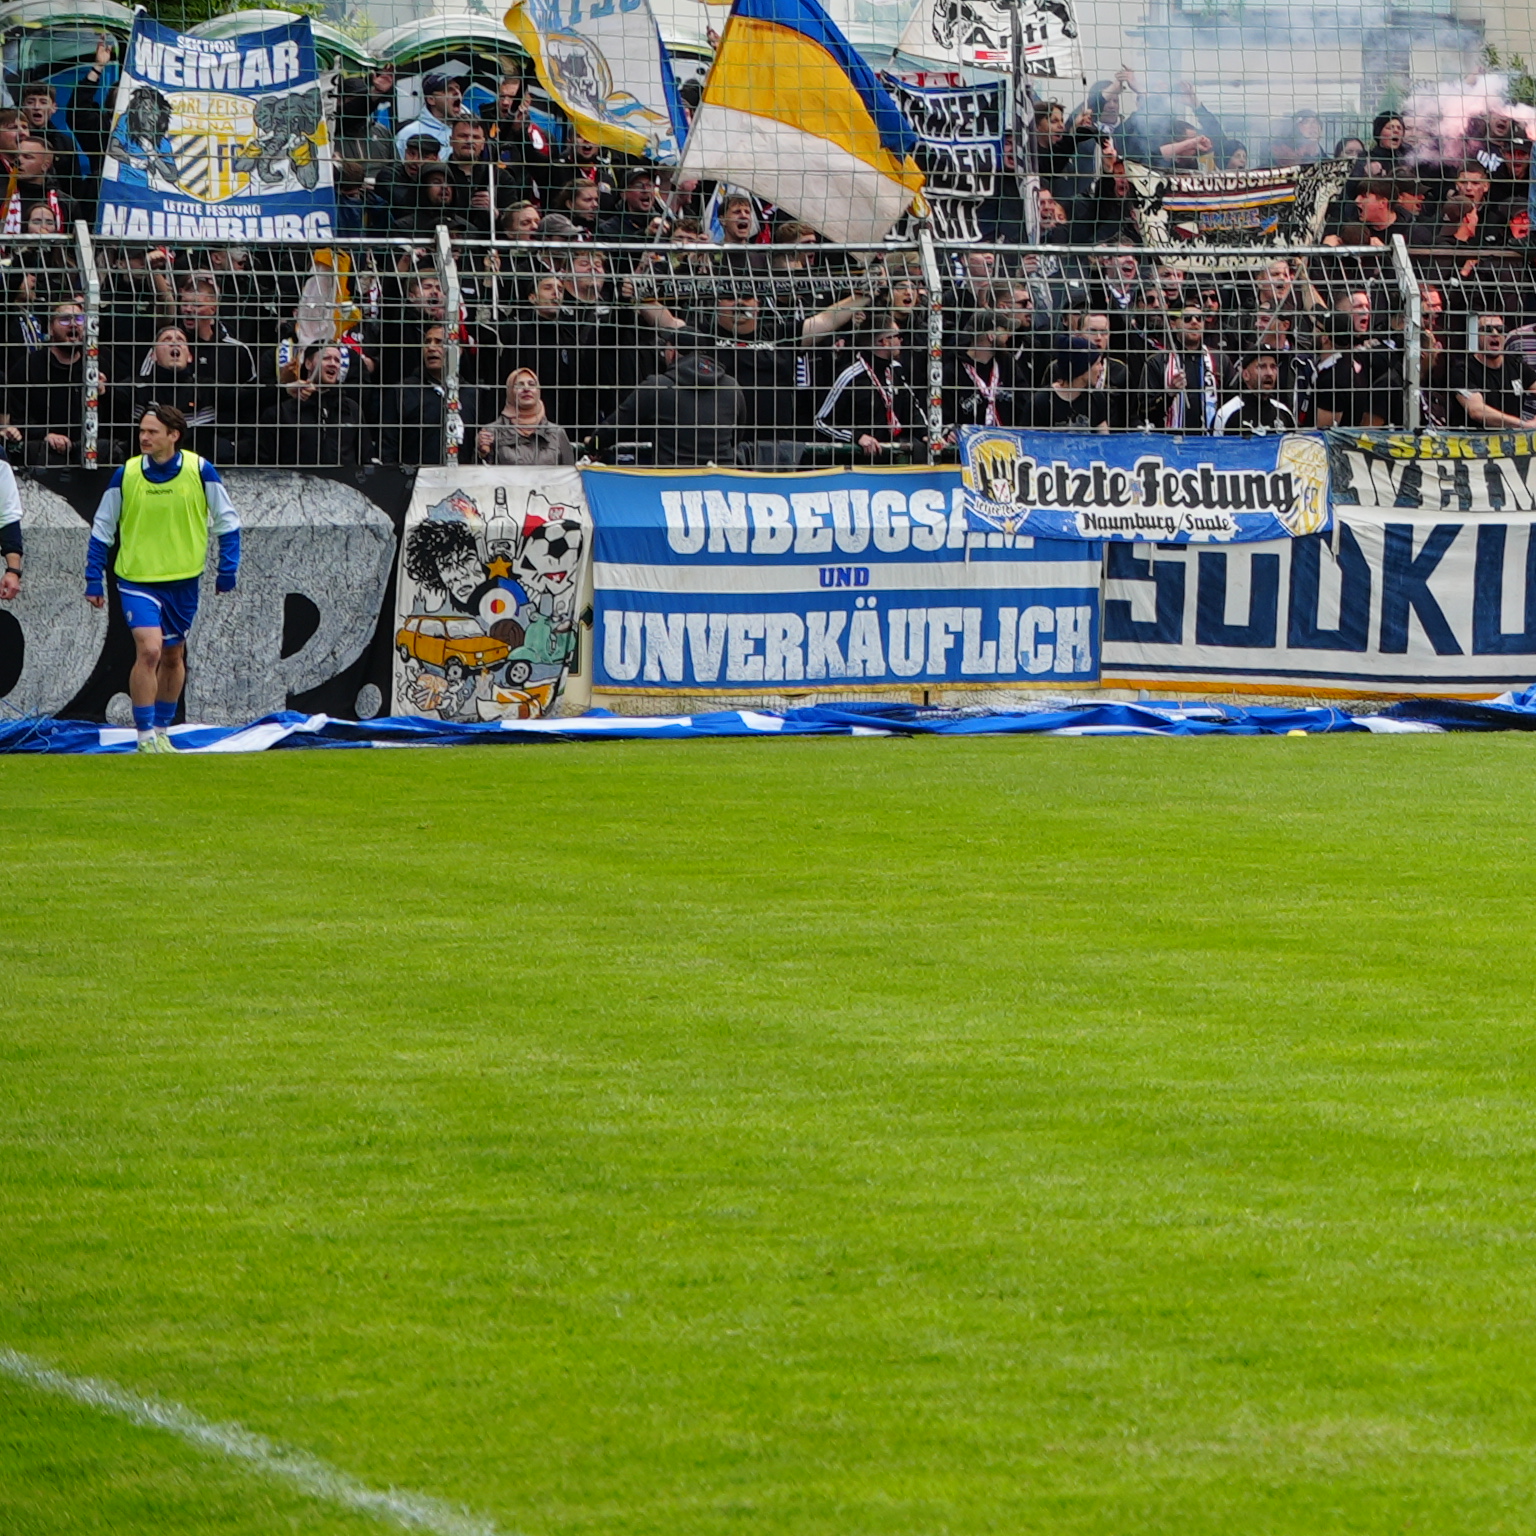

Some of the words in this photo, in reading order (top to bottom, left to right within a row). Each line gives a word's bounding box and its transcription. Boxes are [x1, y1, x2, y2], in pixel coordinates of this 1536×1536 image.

[134, 32, 300, 89] WEIMAR
[176, 35, 236, 53] SEKTION
[101, 202, 336, 240] NAUMBURG
[1013, 461, 1134, 508] Letzte
[1136, 459, 1301, 513] Festung
[660, 488, 1034, 555] UNBEUGSA
[819, 566, 870, 588] UND
[602, 595, 1092, 683] UNVERKÄUFLICH
